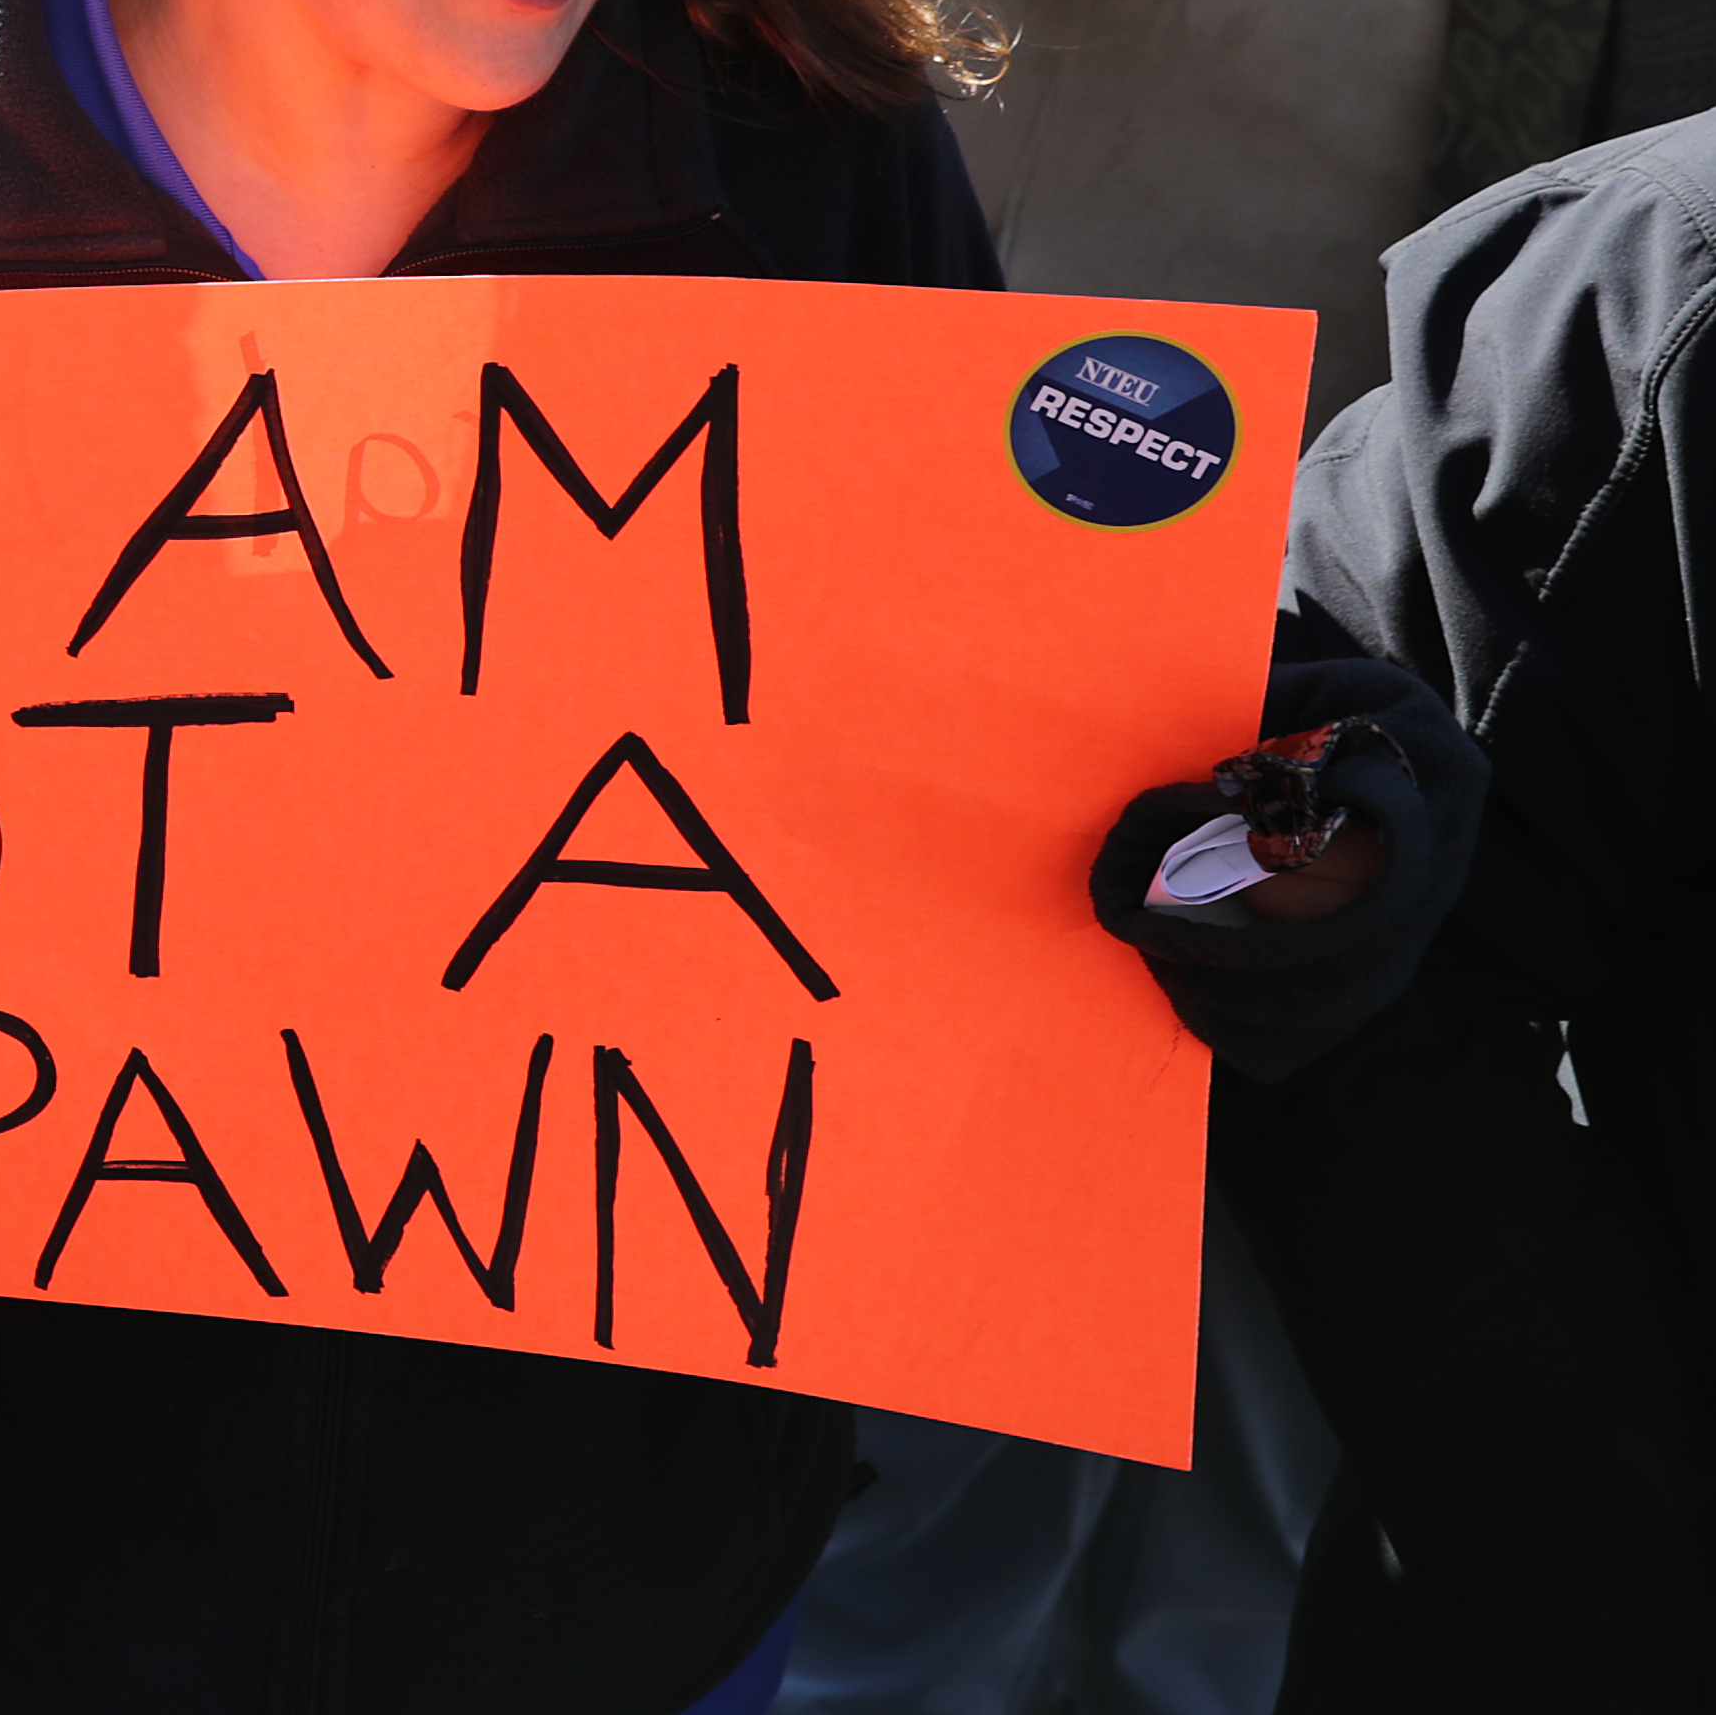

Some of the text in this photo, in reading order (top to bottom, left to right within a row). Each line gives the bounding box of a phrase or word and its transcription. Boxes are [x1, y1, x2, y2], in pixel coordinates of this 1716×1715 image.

[1029, 385, 1222, 480] RESPECT
[1075, 355, 1160, 407] NTEU
[66, 361, 752, 727] AM
[440, 731, 842, 1003] A
